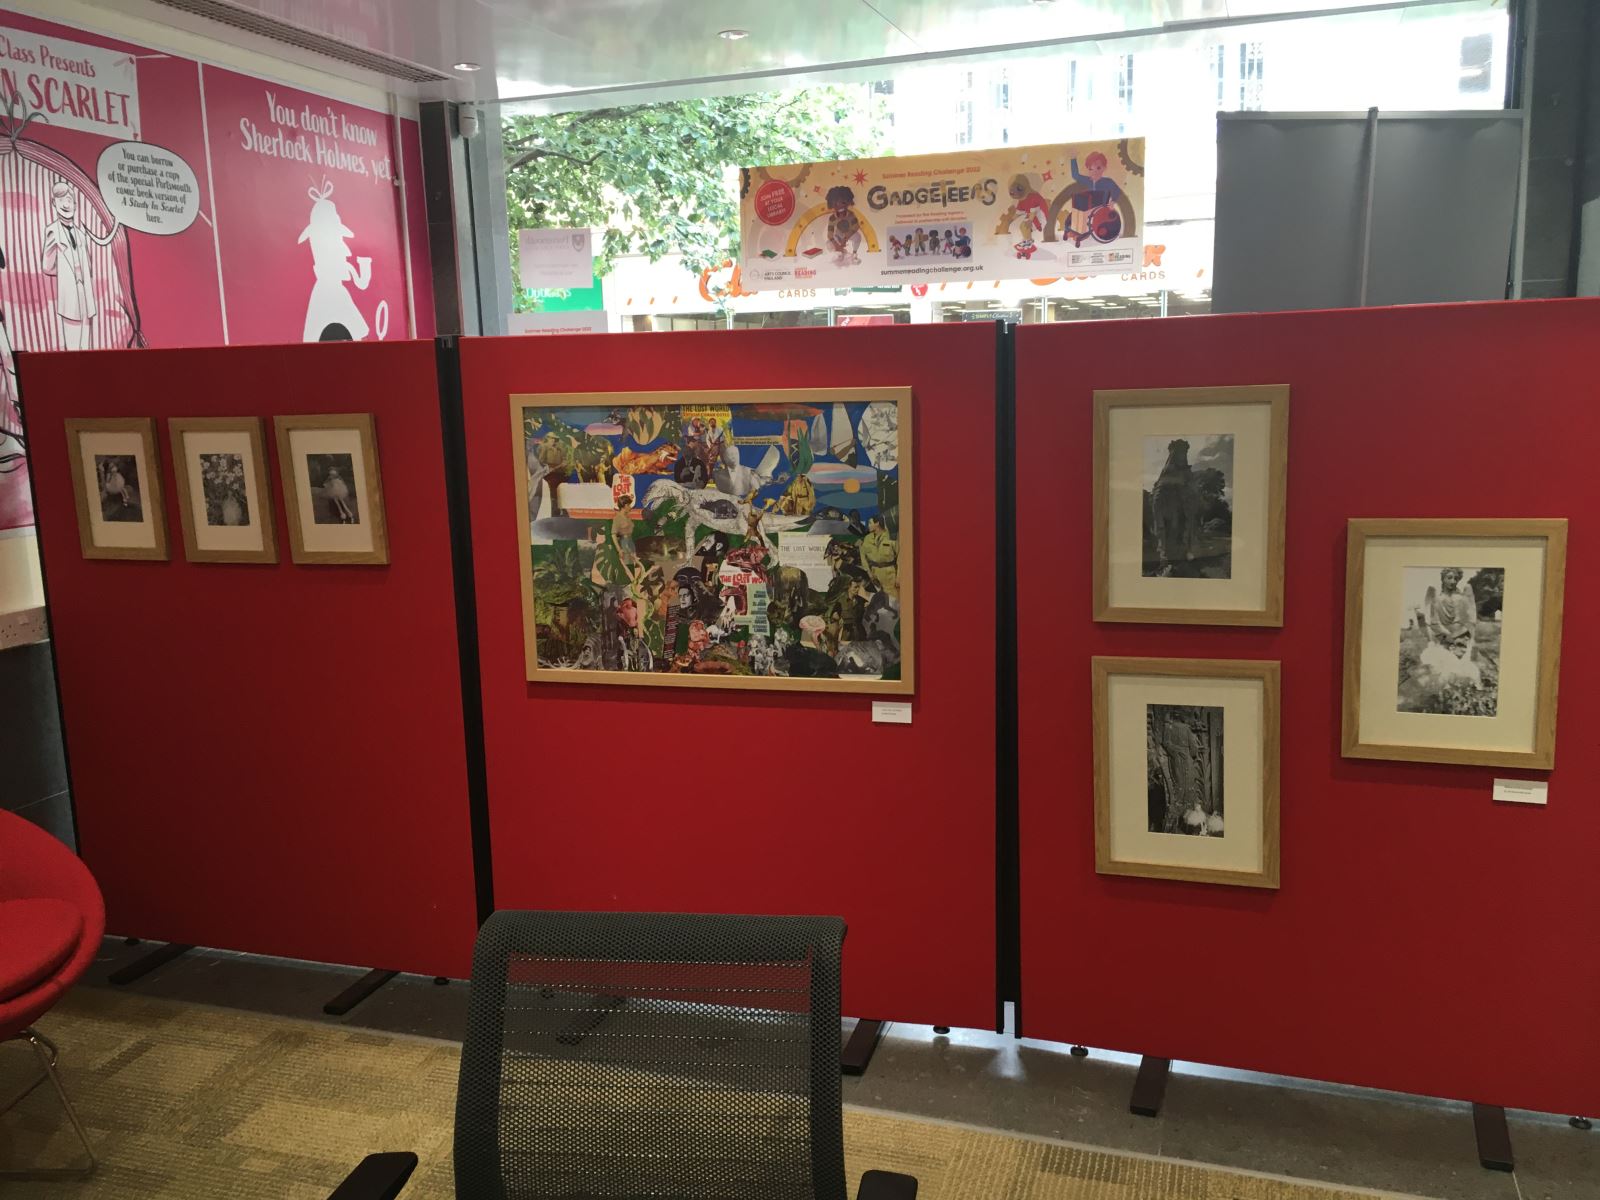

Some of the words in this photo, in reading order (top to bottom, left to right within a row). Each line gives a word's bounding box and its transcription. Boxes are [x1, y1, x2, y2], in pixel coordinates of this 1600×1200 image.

[0, 34, 36, 64] Class
[39, 44, 96, 78] Presents
[27, 73, 130, 127] SCARLET
[265, 90, 299, 129] You
[300, 104, 339, 138] don't
[341, 114, 377, 147] know
[121, 147, 135, 160] You
[136, 154, 150, 164] can
[150, 154, 174, 167] borrow
[239, 117, 313, 163] Sherlock
[315, 134, 369, 177] Holmes,
[117, 162, 126, 171] or
[126, 164, 158, 177] purchase
[107, 170, 116, 183] of
[116, 172, 129, 184] the
[130, 175, 154, 188] special
[155, 177, 192, 193] Portsmouth
[115, 186, 135, 196] comic
[154, 192, 178, 204] version
[121, 196, 127, 206] A
[128, 197, 149, 210] Study
[160, 202, 184, 214] Scarlet
[1121, 270, 1166, 282] CARDS
[778, 288, 816, 299] CARDS
